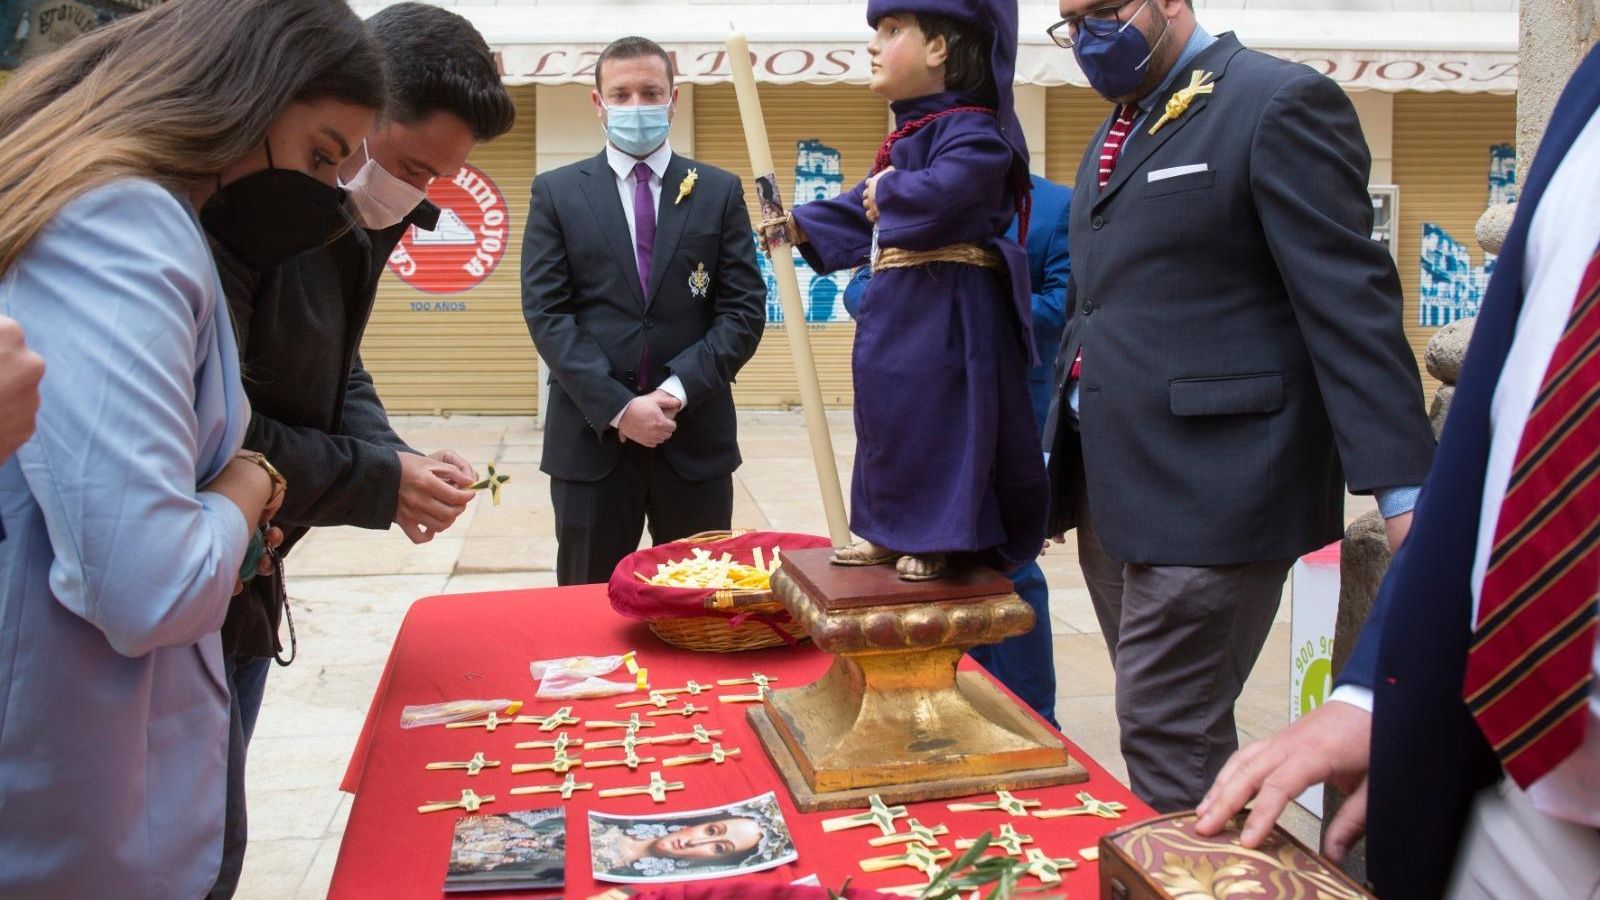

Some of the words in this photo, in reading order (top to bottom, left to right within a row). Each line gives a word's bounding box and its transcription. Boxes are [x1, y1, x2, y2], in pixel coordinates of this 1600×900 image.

[452, 167, 505, 277] HINOJOSA
[410, 302, 431, 312] 100
[1296, 640, 1314, 674] 900
[1320, 635, 1334, 656] 90
